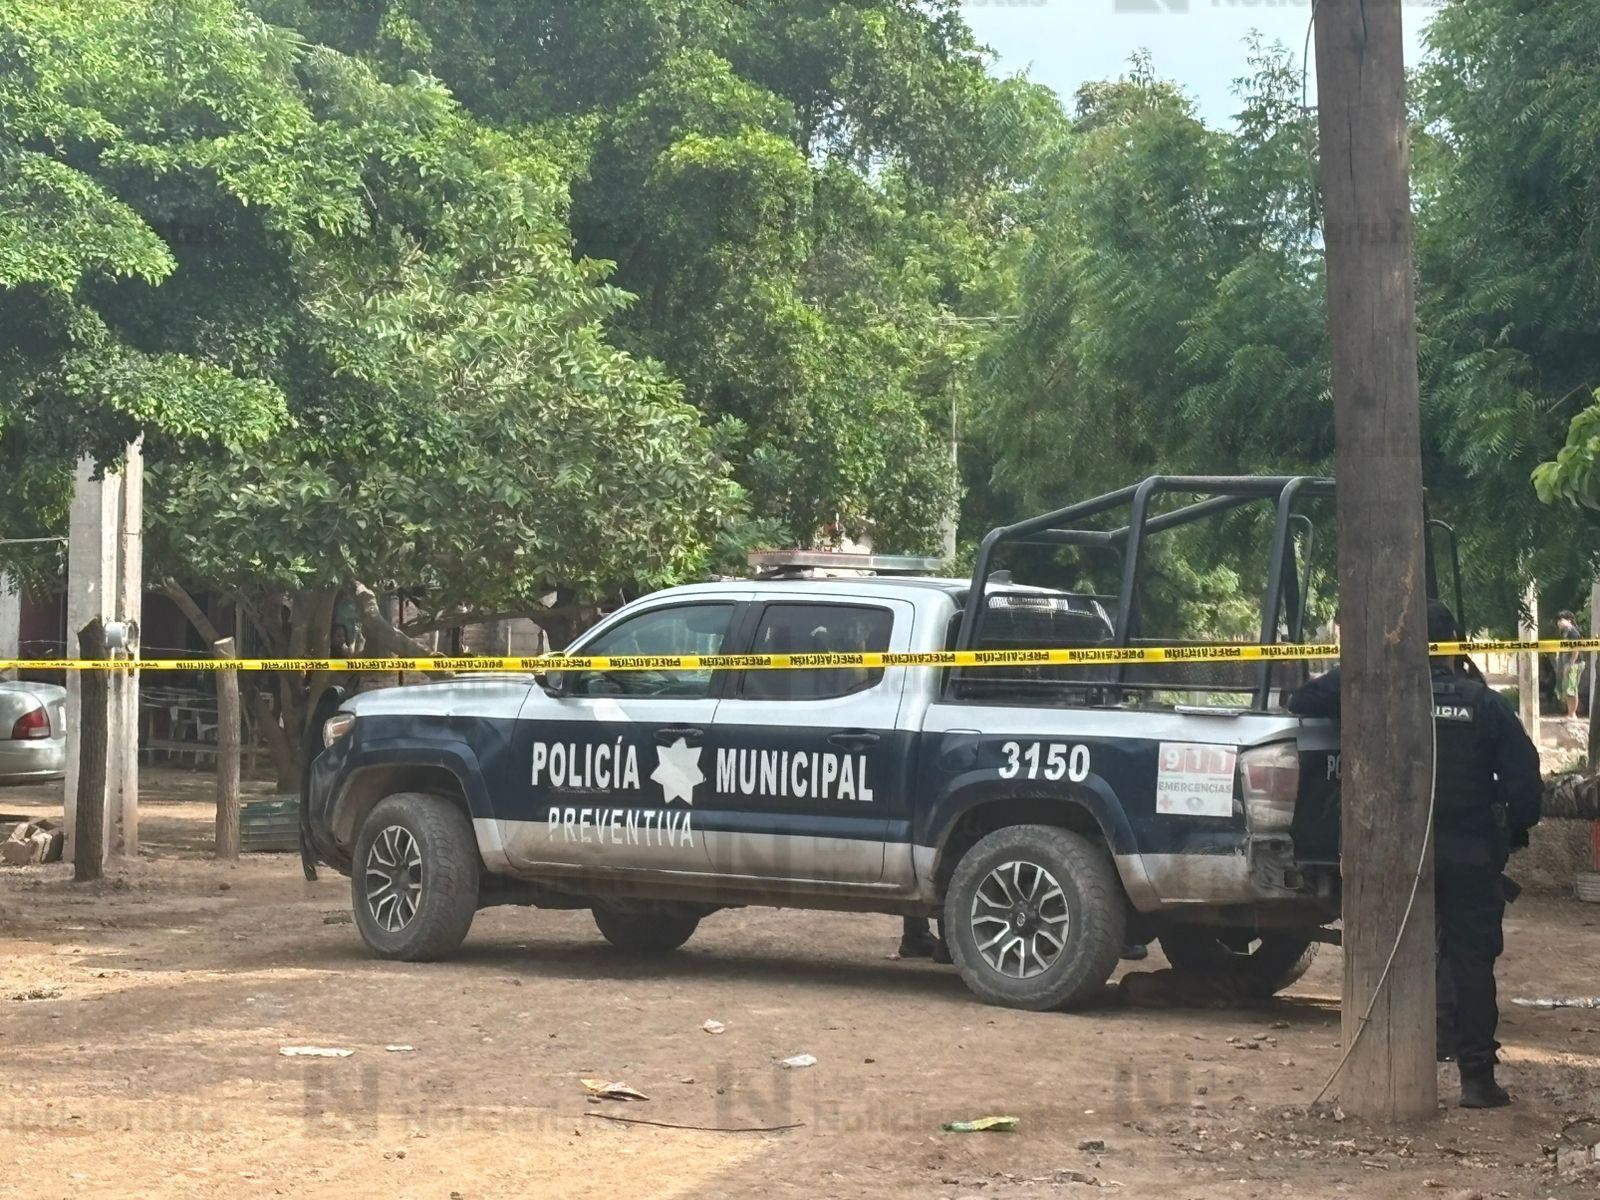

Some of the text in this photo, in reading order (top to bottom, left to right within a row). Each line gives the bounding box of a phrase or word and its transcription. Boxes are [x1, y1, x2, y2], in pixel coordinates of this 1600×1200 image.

[531, 736, 874, 802] POLICÍA MUNICIPAL
[998, 741, 1091, 783] 3150
[1165, 748, 1227, 770] 911
[1158, 781, 1233, 794] EMERGENCIAS
[548, 806, 694, 849] PREVENTIVA
